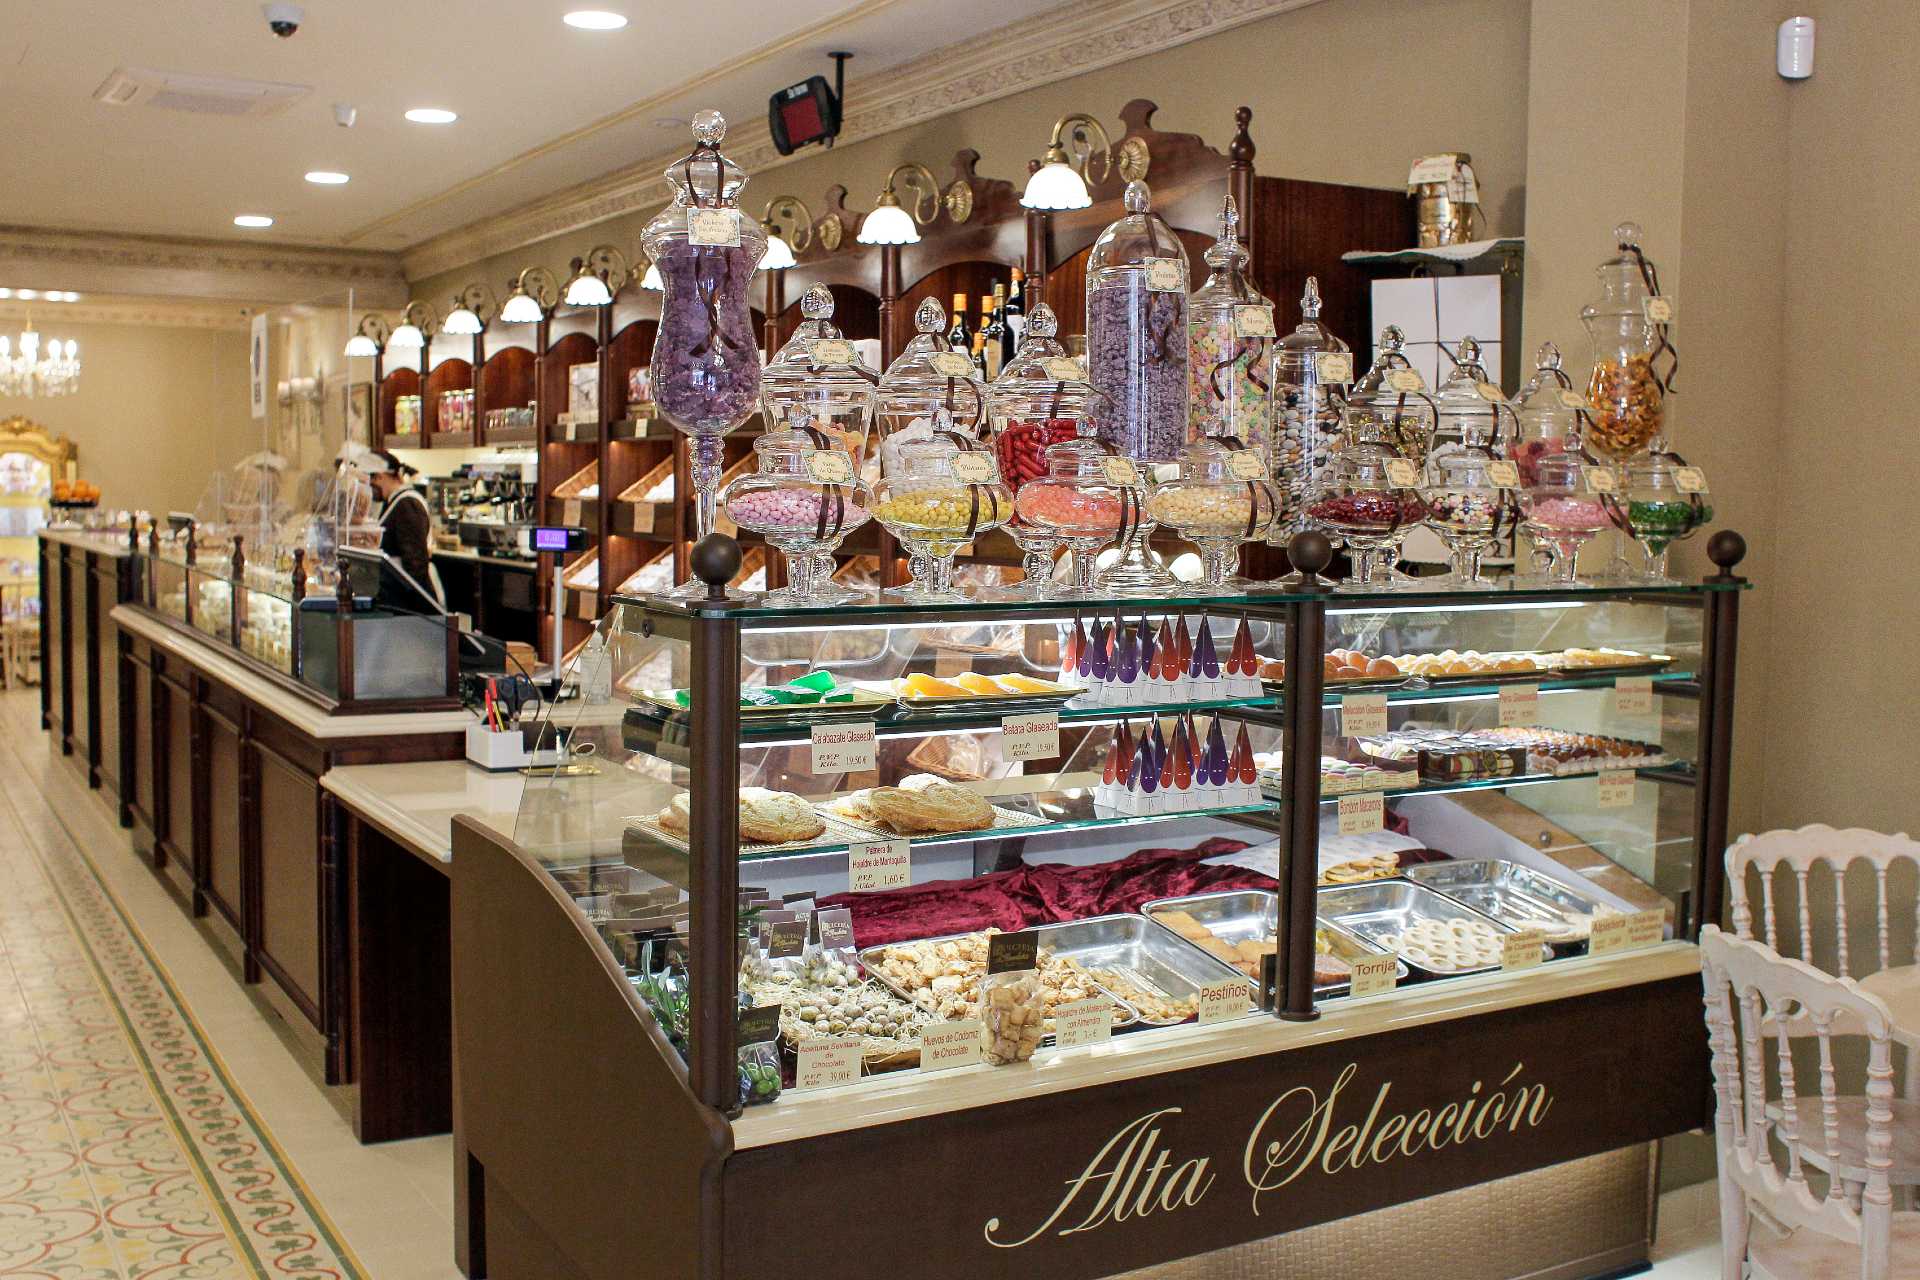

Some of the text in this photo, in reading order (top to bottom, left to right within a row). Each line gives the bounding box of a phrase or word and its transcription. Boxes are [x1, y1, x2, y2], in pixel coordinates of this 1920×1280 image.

[1355, 960, 1396, 976] Torrija
[1201, 983, 1248, 1003] Pestiños
[923, 1035, 945, 1047] Huevos
[945, 1033, 953, 1043] de
[932, 1046, 969, 1059] de Chocolate
[984, 1062, 1553, 1248] Alta Selección
